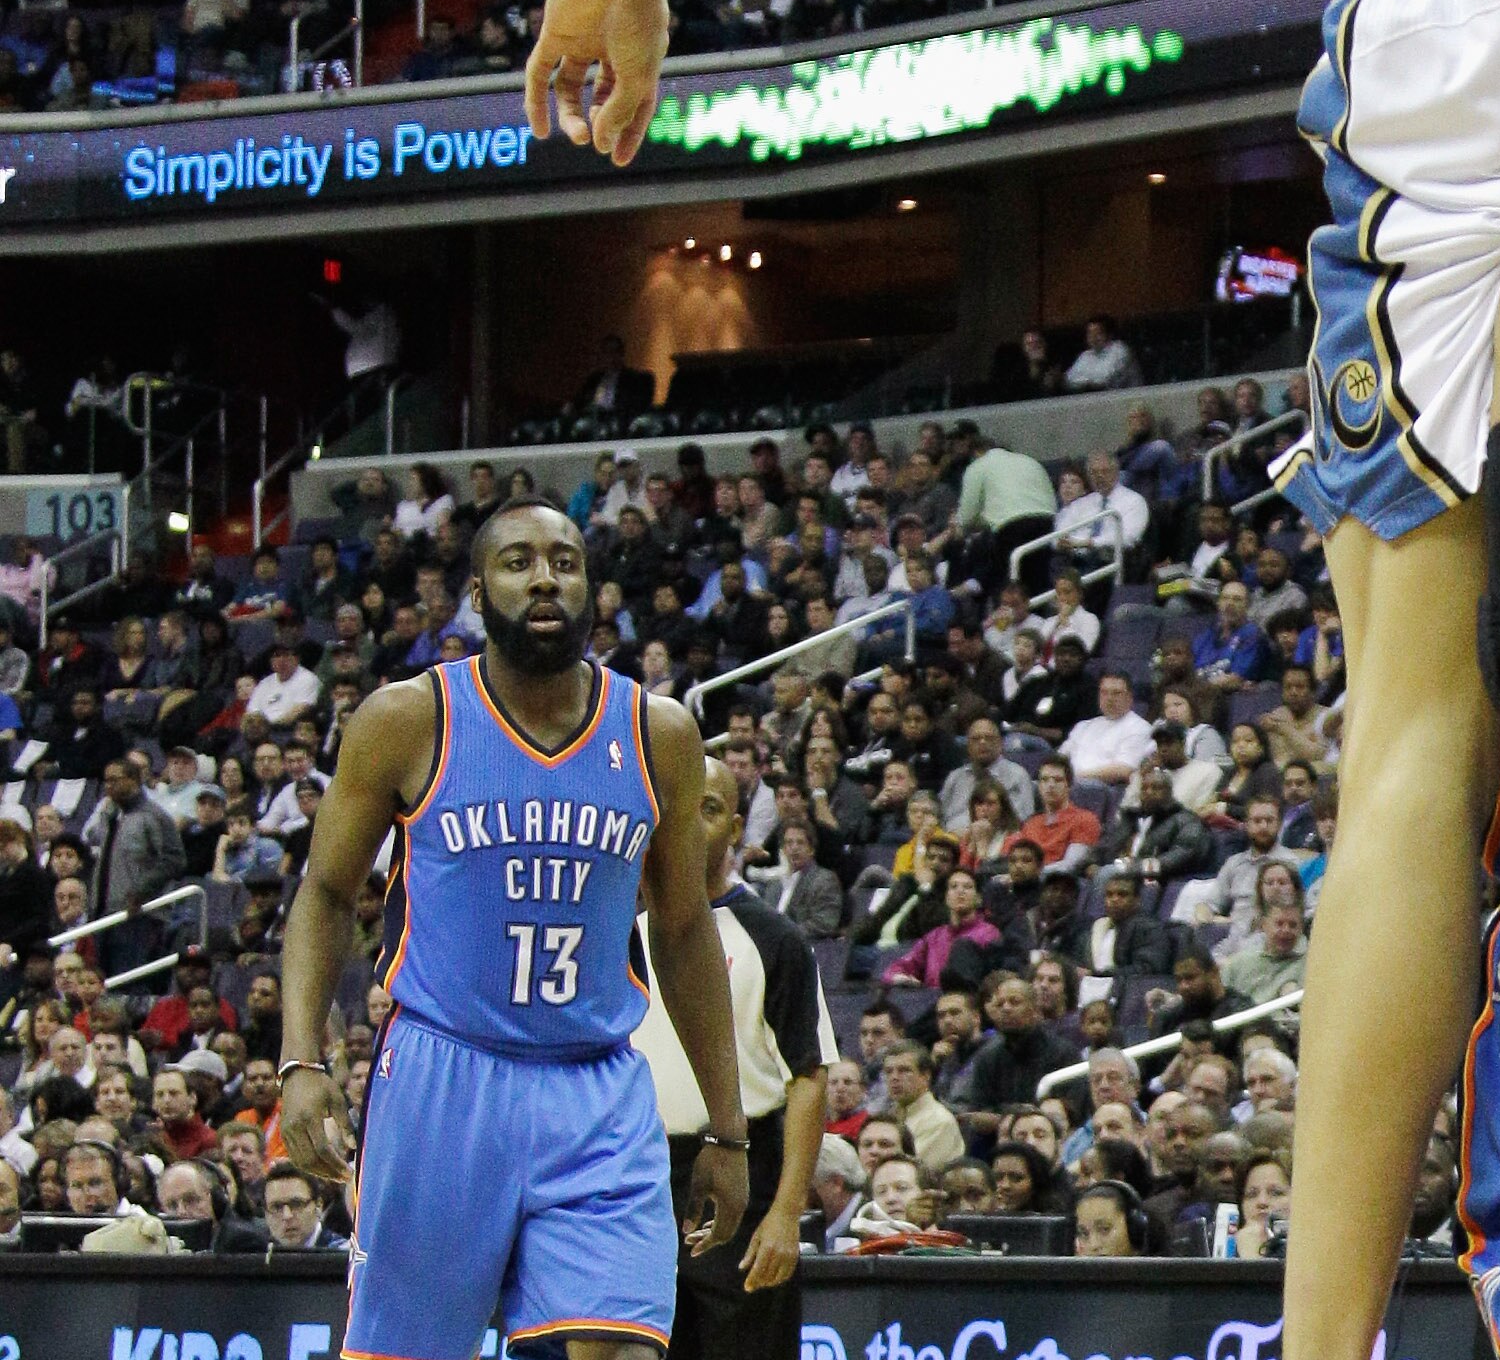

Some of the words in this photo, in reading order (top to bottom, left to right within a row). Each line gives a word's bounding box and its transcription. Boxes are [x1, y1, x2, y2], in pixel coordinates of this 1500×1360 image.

[125, 133, 333, 203] Simplicity
[344, 127, 381, 180] is
[393, 121, 536, 176] Power
[46, 491, 115, 537] 103
[439, 798, 649, 864] OKLAHOMA
[504, 855, 593, 903] CITY
[506, 923, 584, 1006] 13
